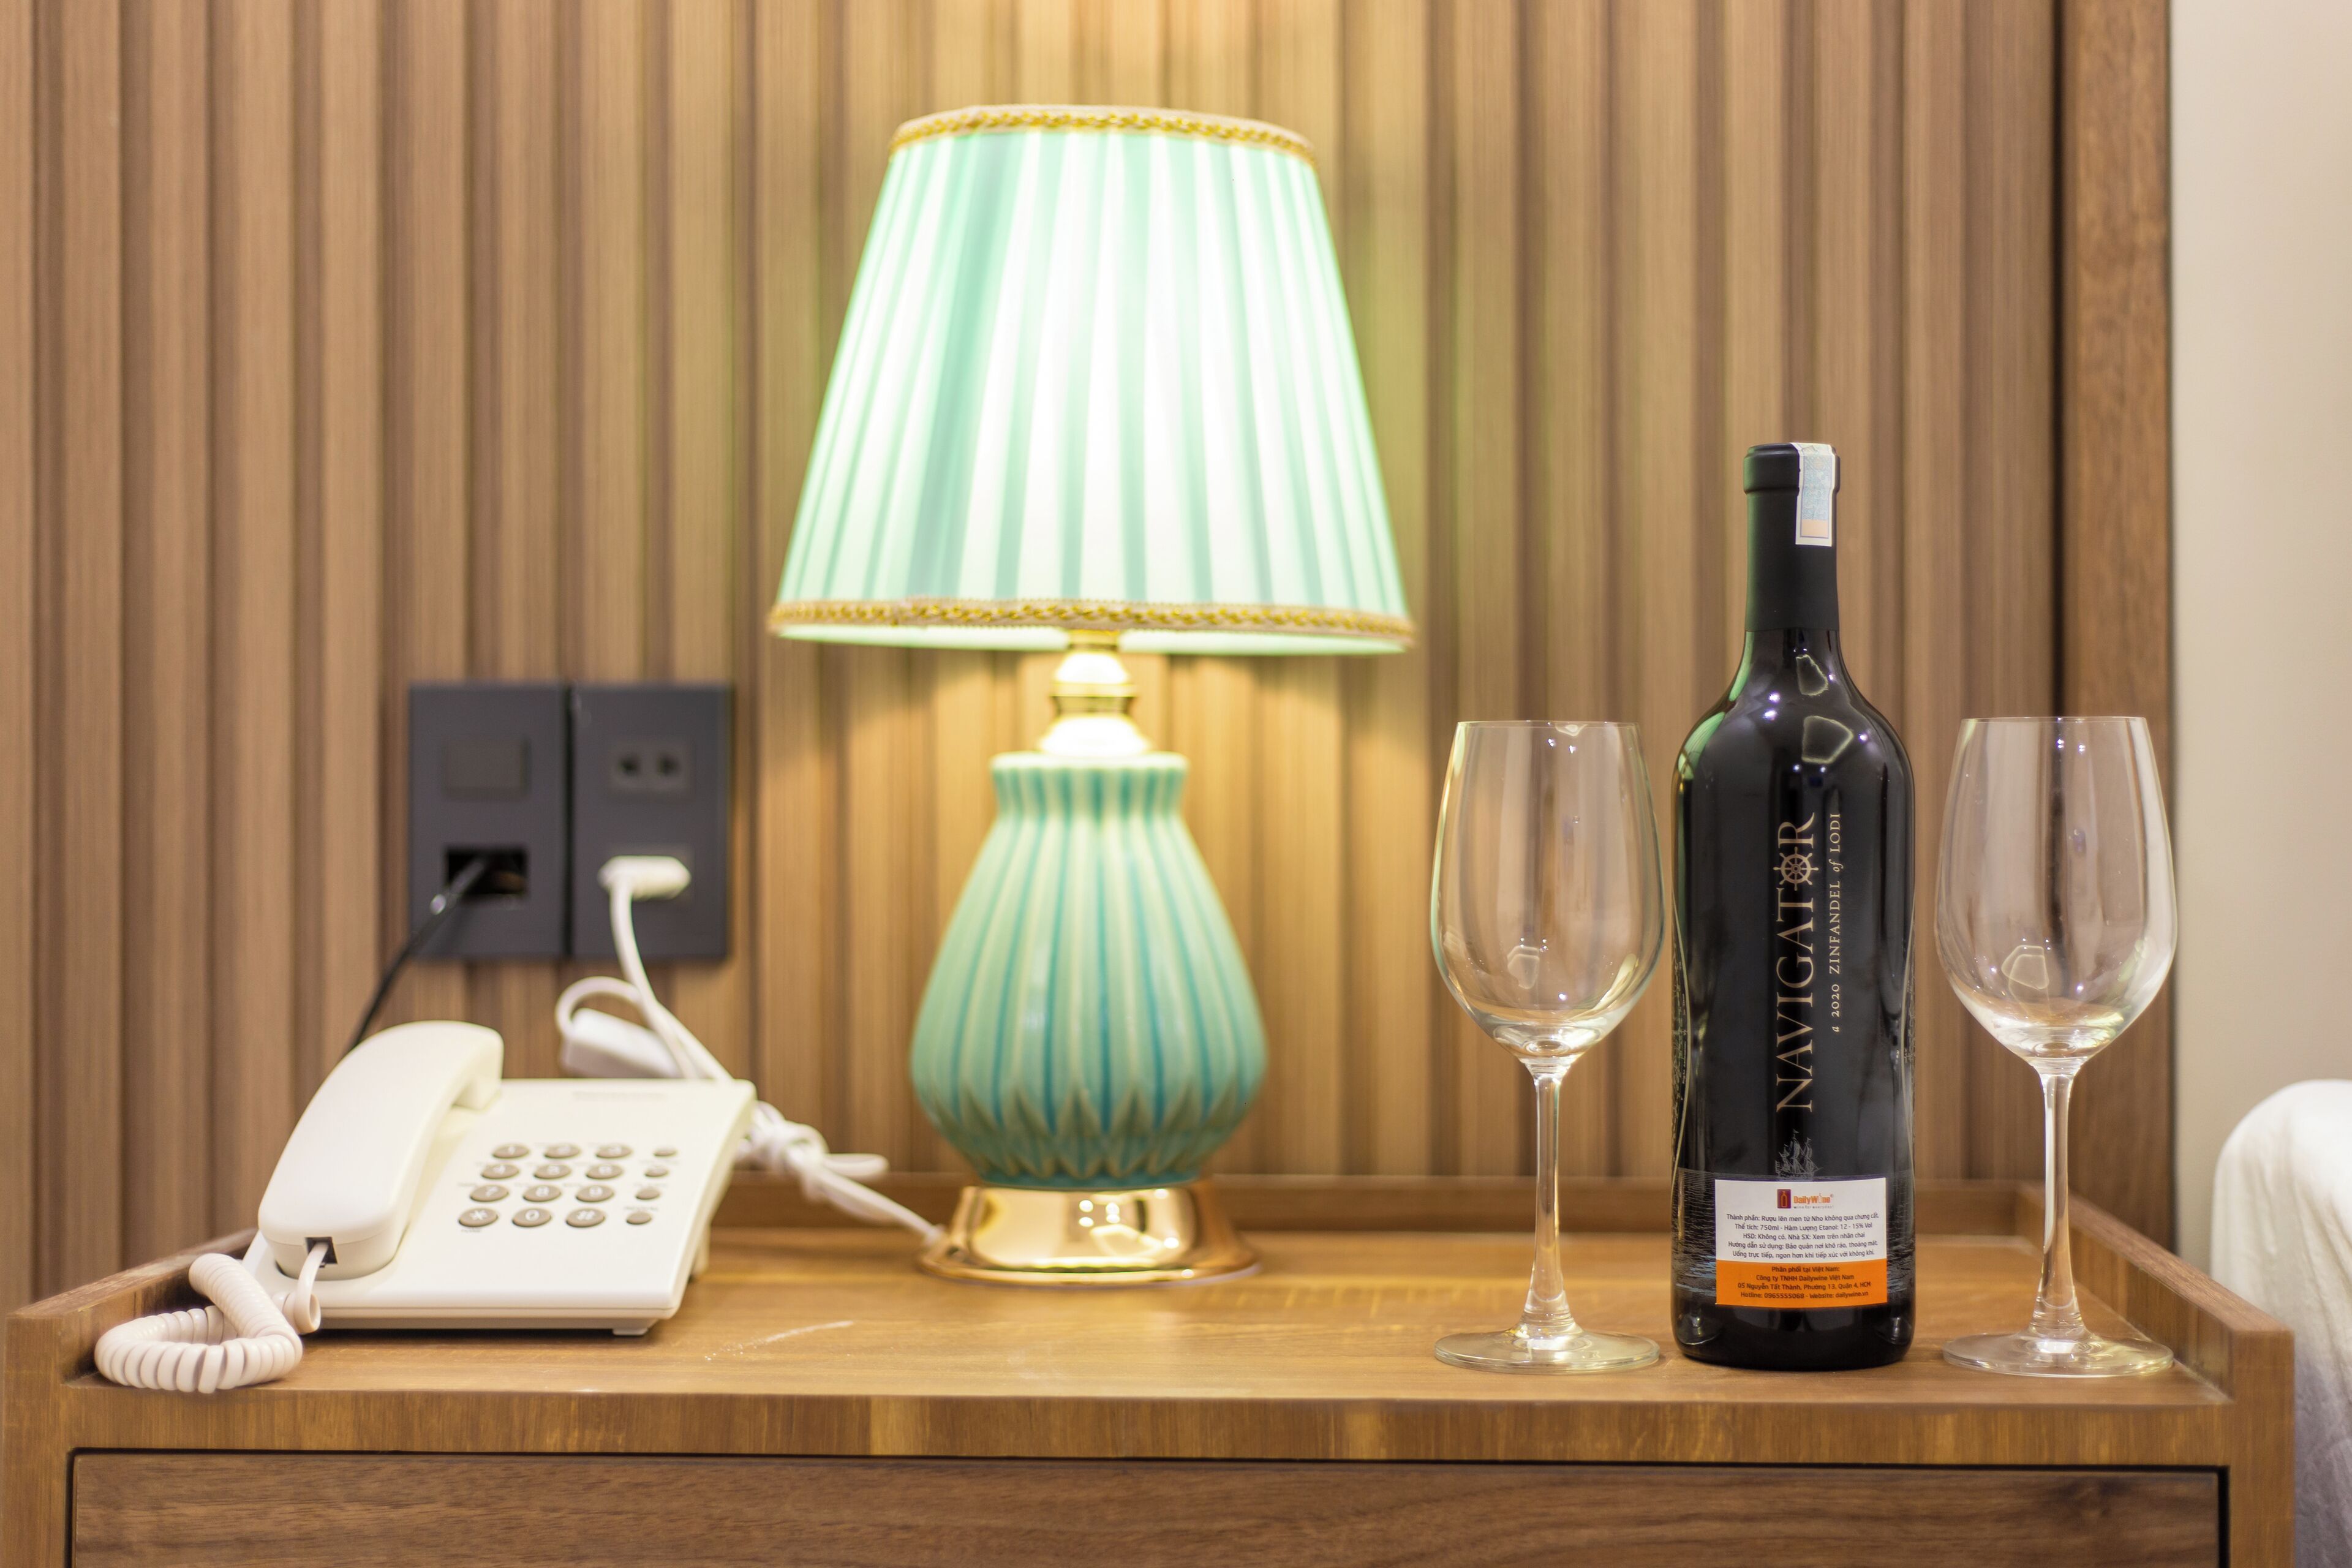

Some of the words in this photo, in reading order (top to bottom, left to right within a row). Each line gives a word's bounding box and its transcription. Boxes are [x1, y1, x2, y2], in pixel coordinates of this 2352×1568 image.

[1830, 813, 1841, 853] LODI
[1828, 859, 1844, 872] of
[1829, 881, 1841, 974] ZINFANDEL
[1831, 984, 1840, 1017] 2020
